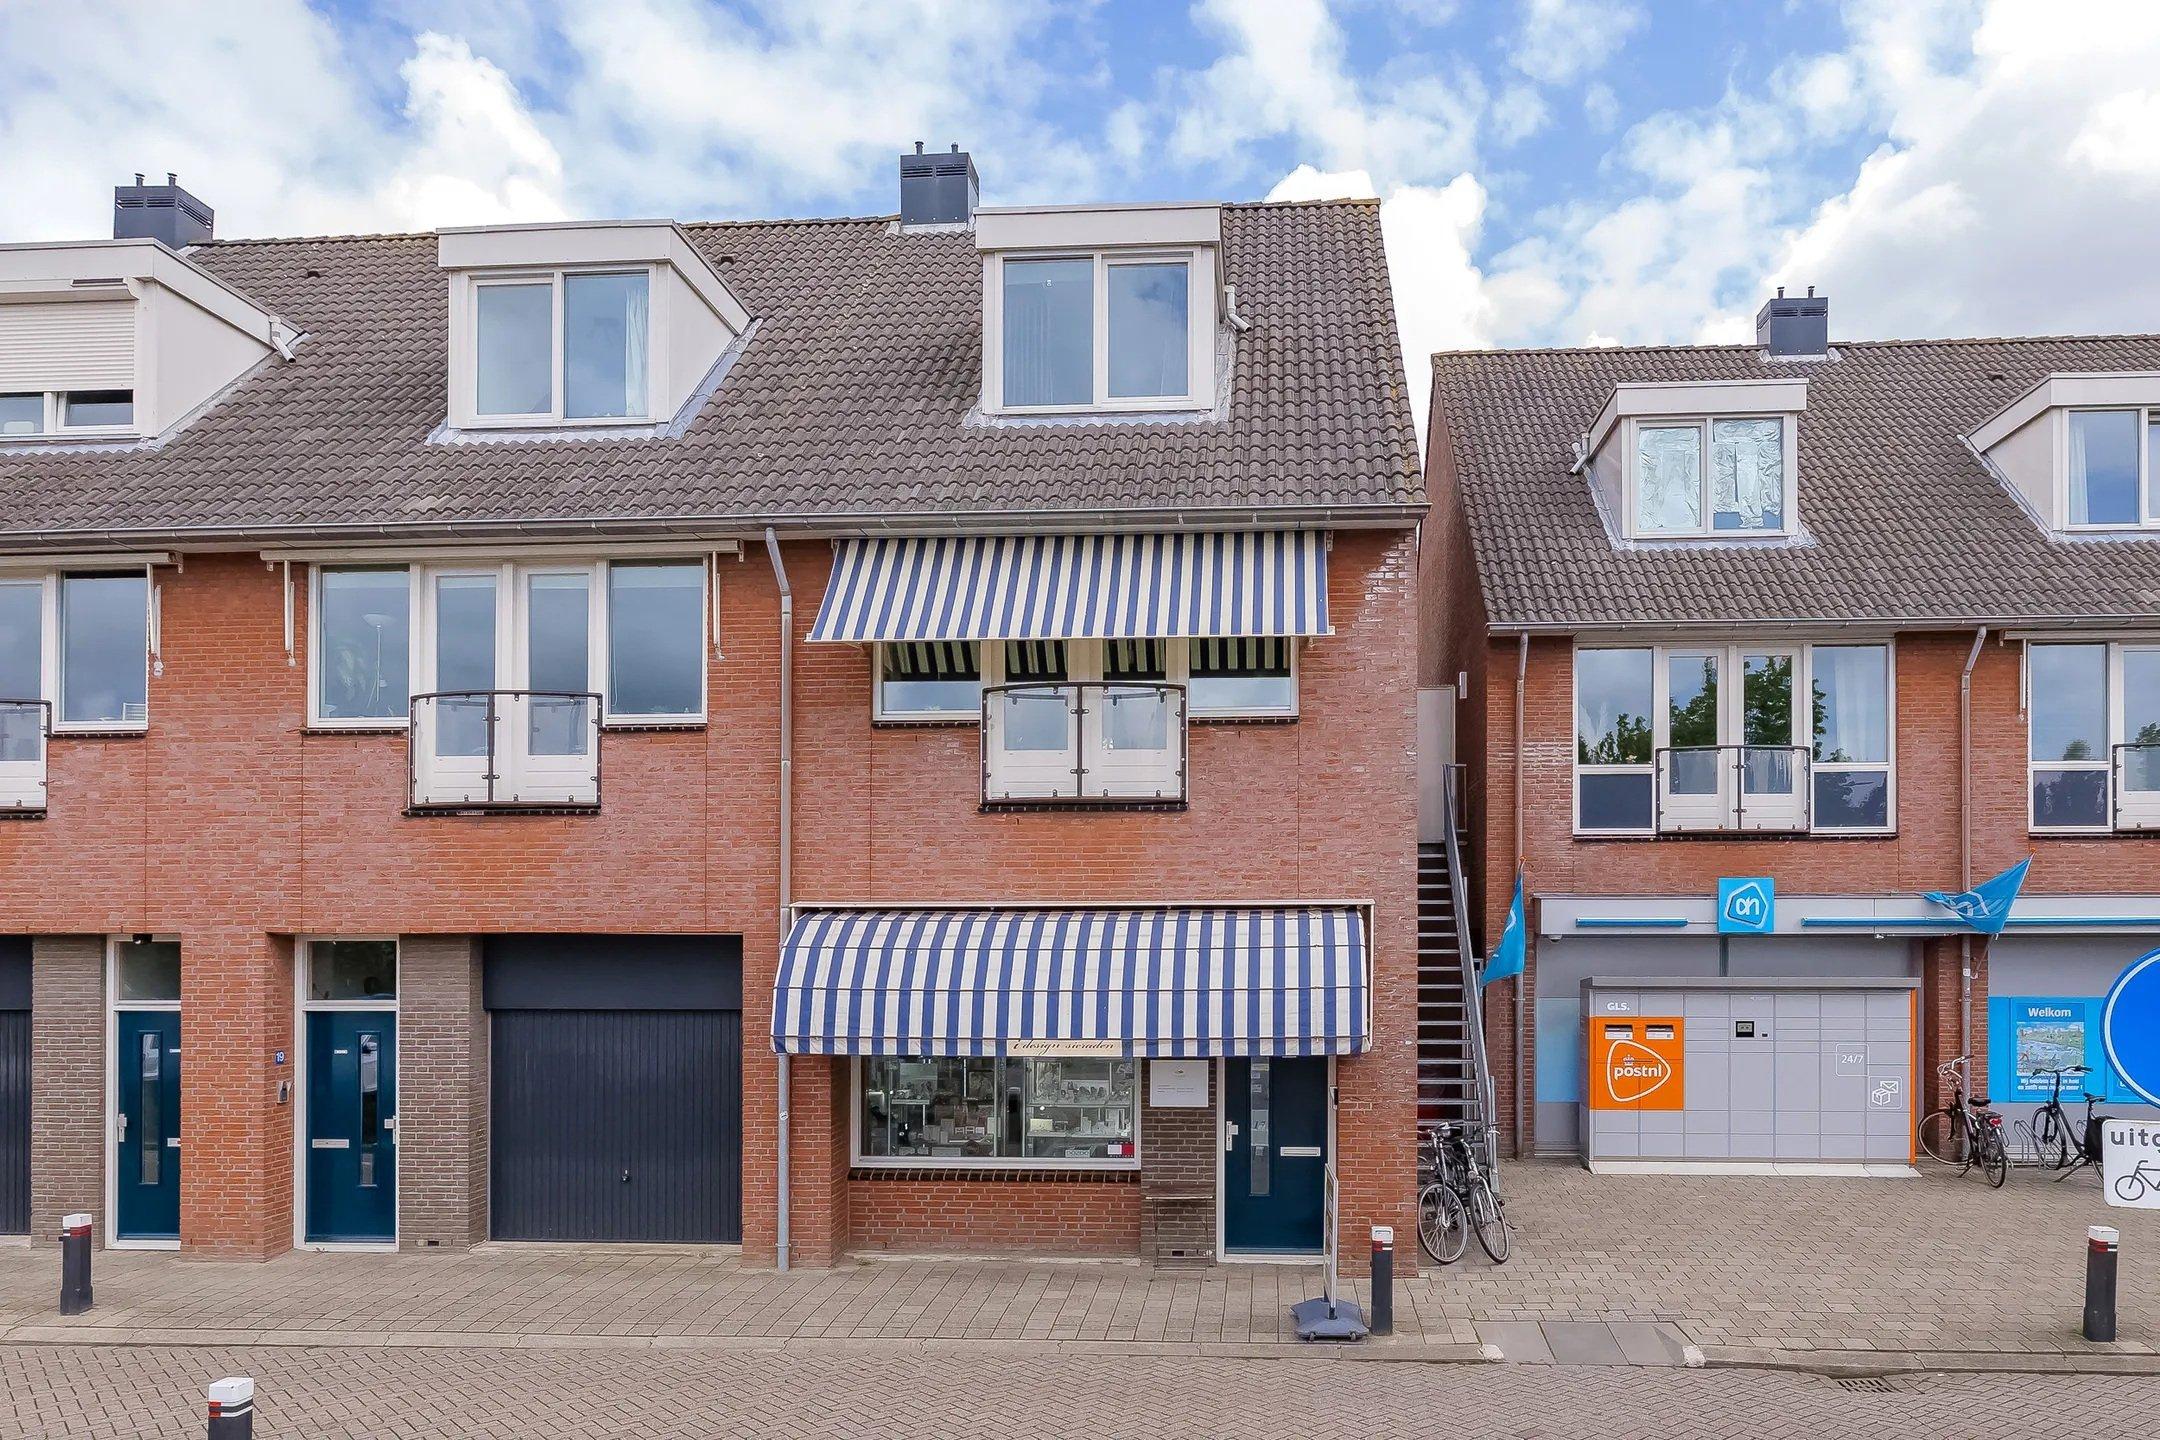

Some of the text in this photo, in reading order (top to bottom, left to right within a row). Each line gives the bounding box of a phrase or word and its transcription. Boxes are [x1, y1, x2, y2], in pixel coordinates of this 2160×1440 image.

[1606, 1002, 1630, 1011] GLS.
[2028, 1007, 2072, 1017] Welkom
[1022, 1039, 1060, 1056] design
[1065, 1039, 1115, 1050] sieraden
[276, 1051, 284, 1062] 19
[1841, 1055, 1864, 1064] 24/7
[1613, 1063, 1662, 1081] postnl
